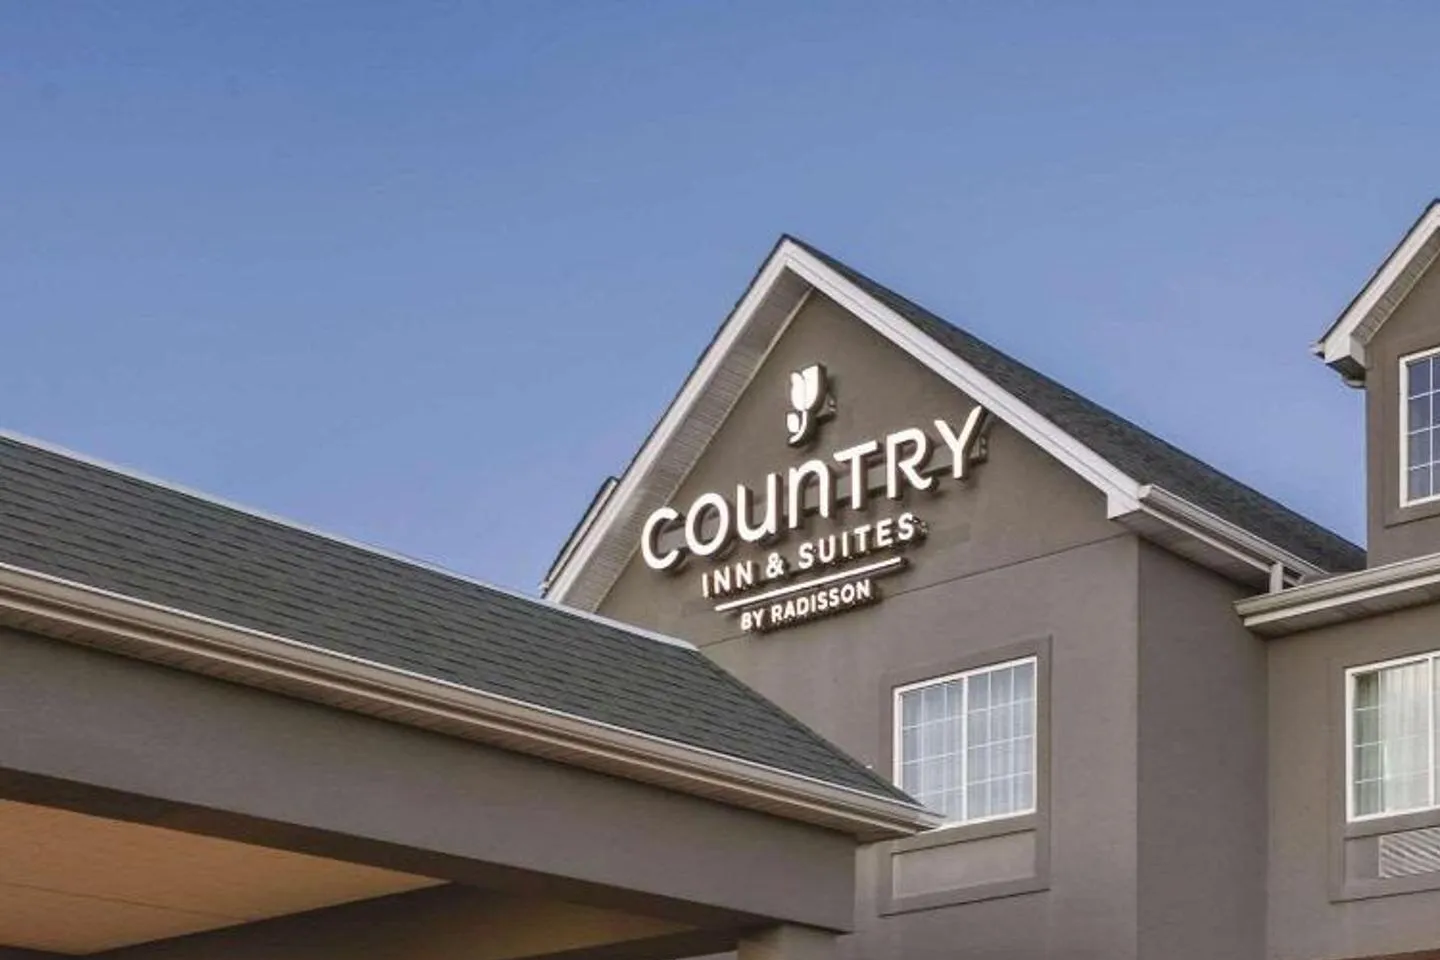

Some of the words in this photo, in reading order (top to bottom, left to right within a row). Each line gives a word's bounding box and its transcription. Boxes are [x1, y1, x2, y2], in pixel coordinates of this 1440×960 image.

[701, 560, 754, 598] INN
[765, 553, 785, 579] &
[798, 513, 916, 570] SUITES
[740, 610, 764, 631] BY
[771, 579, 871, 623] RADISSON
